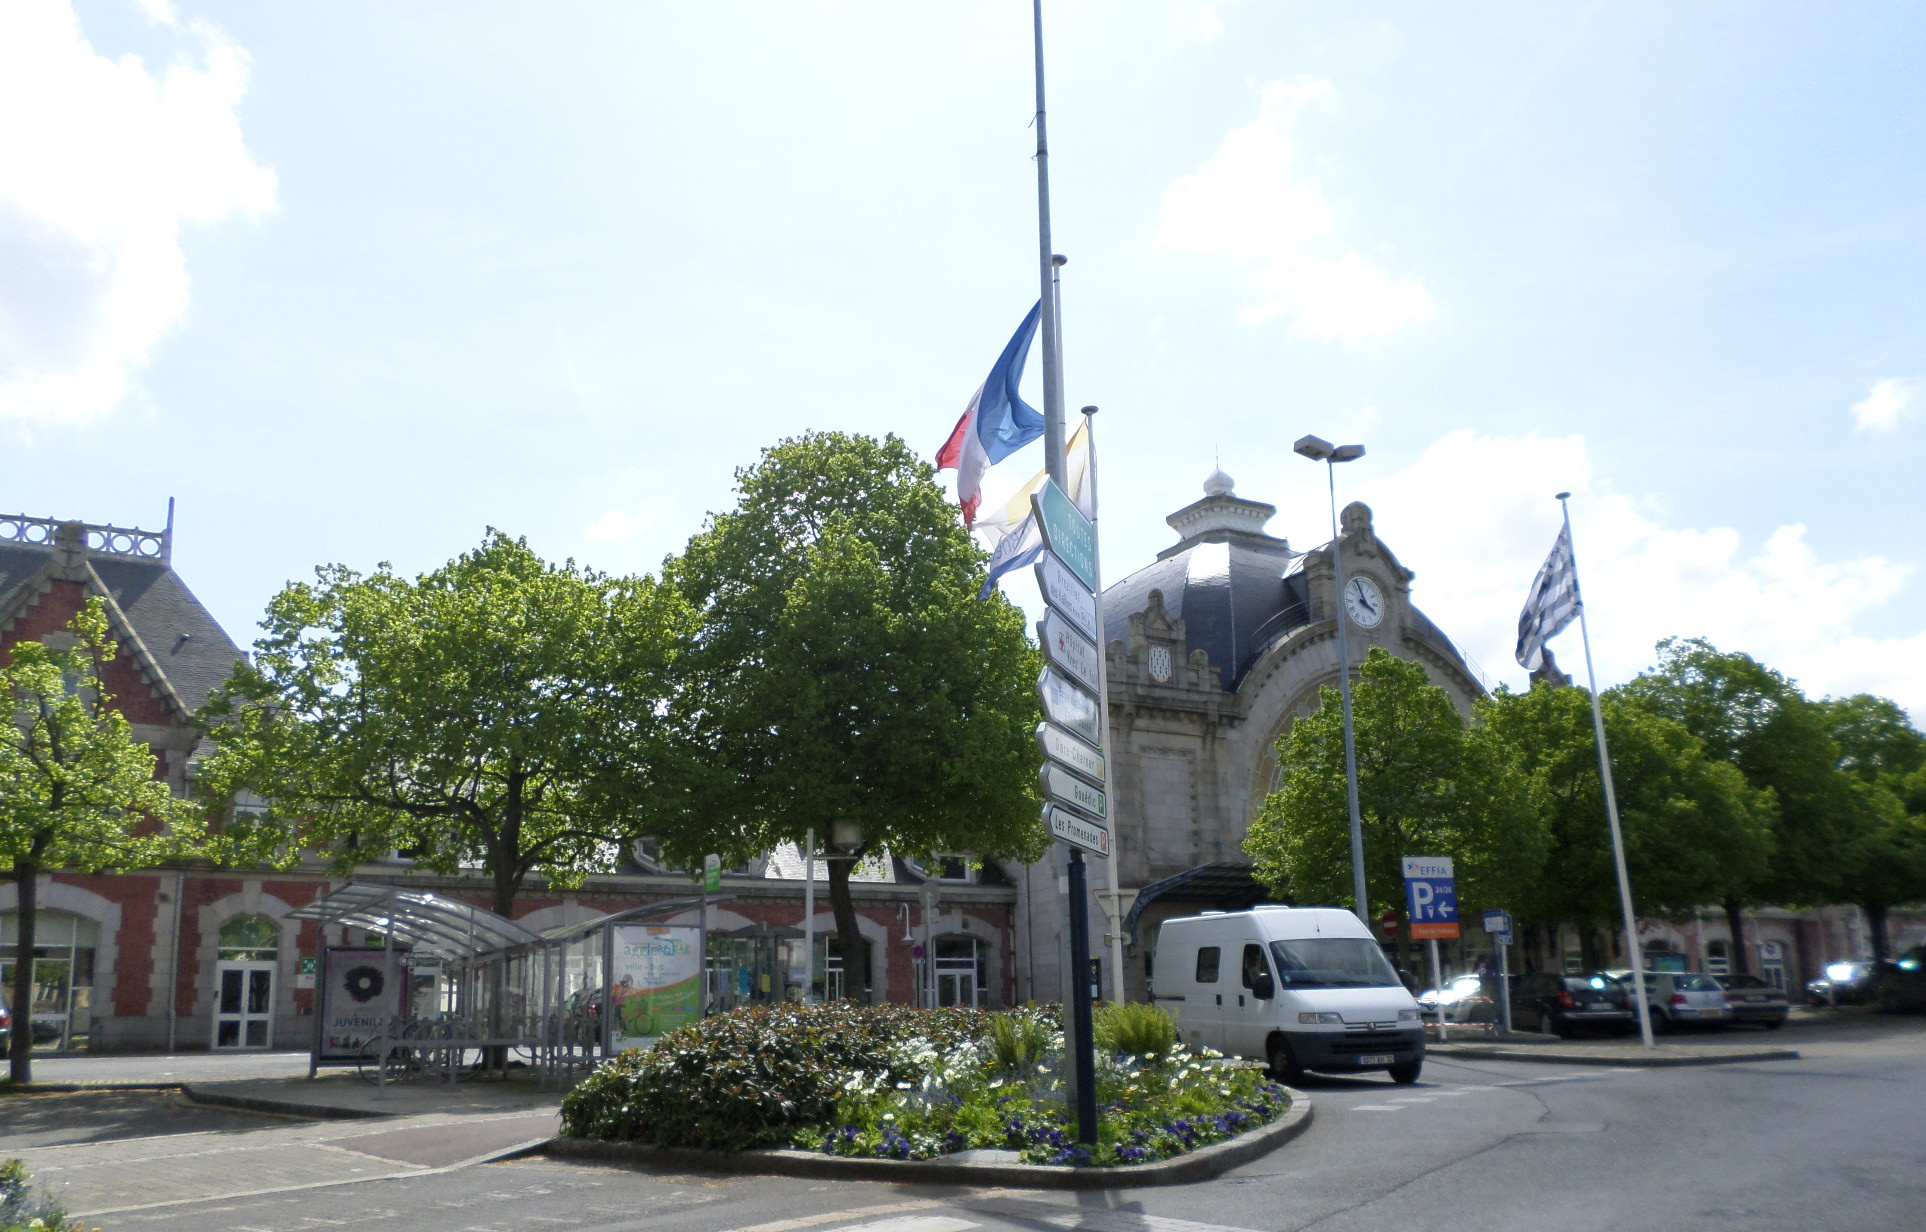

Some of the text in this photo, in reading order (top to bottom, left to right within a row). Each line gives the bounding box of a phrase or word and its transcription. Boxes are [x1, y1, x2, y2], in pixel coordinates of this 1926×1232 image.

[1068, 513, 1092, 552] TOUTES
[1053, 523, 1092, 577] DIRECTIONS
[1065, 630, 1085, 658] Hôpital
[1074, 784, 1096, 808] Gouédic
[1055, 814, 1065, 832] Les
[1067, 820, 1099, 846] Promenades
[1420, 866, 1447, 875] EFFIA
[1412, 882, 1453, 919] P 24/24
